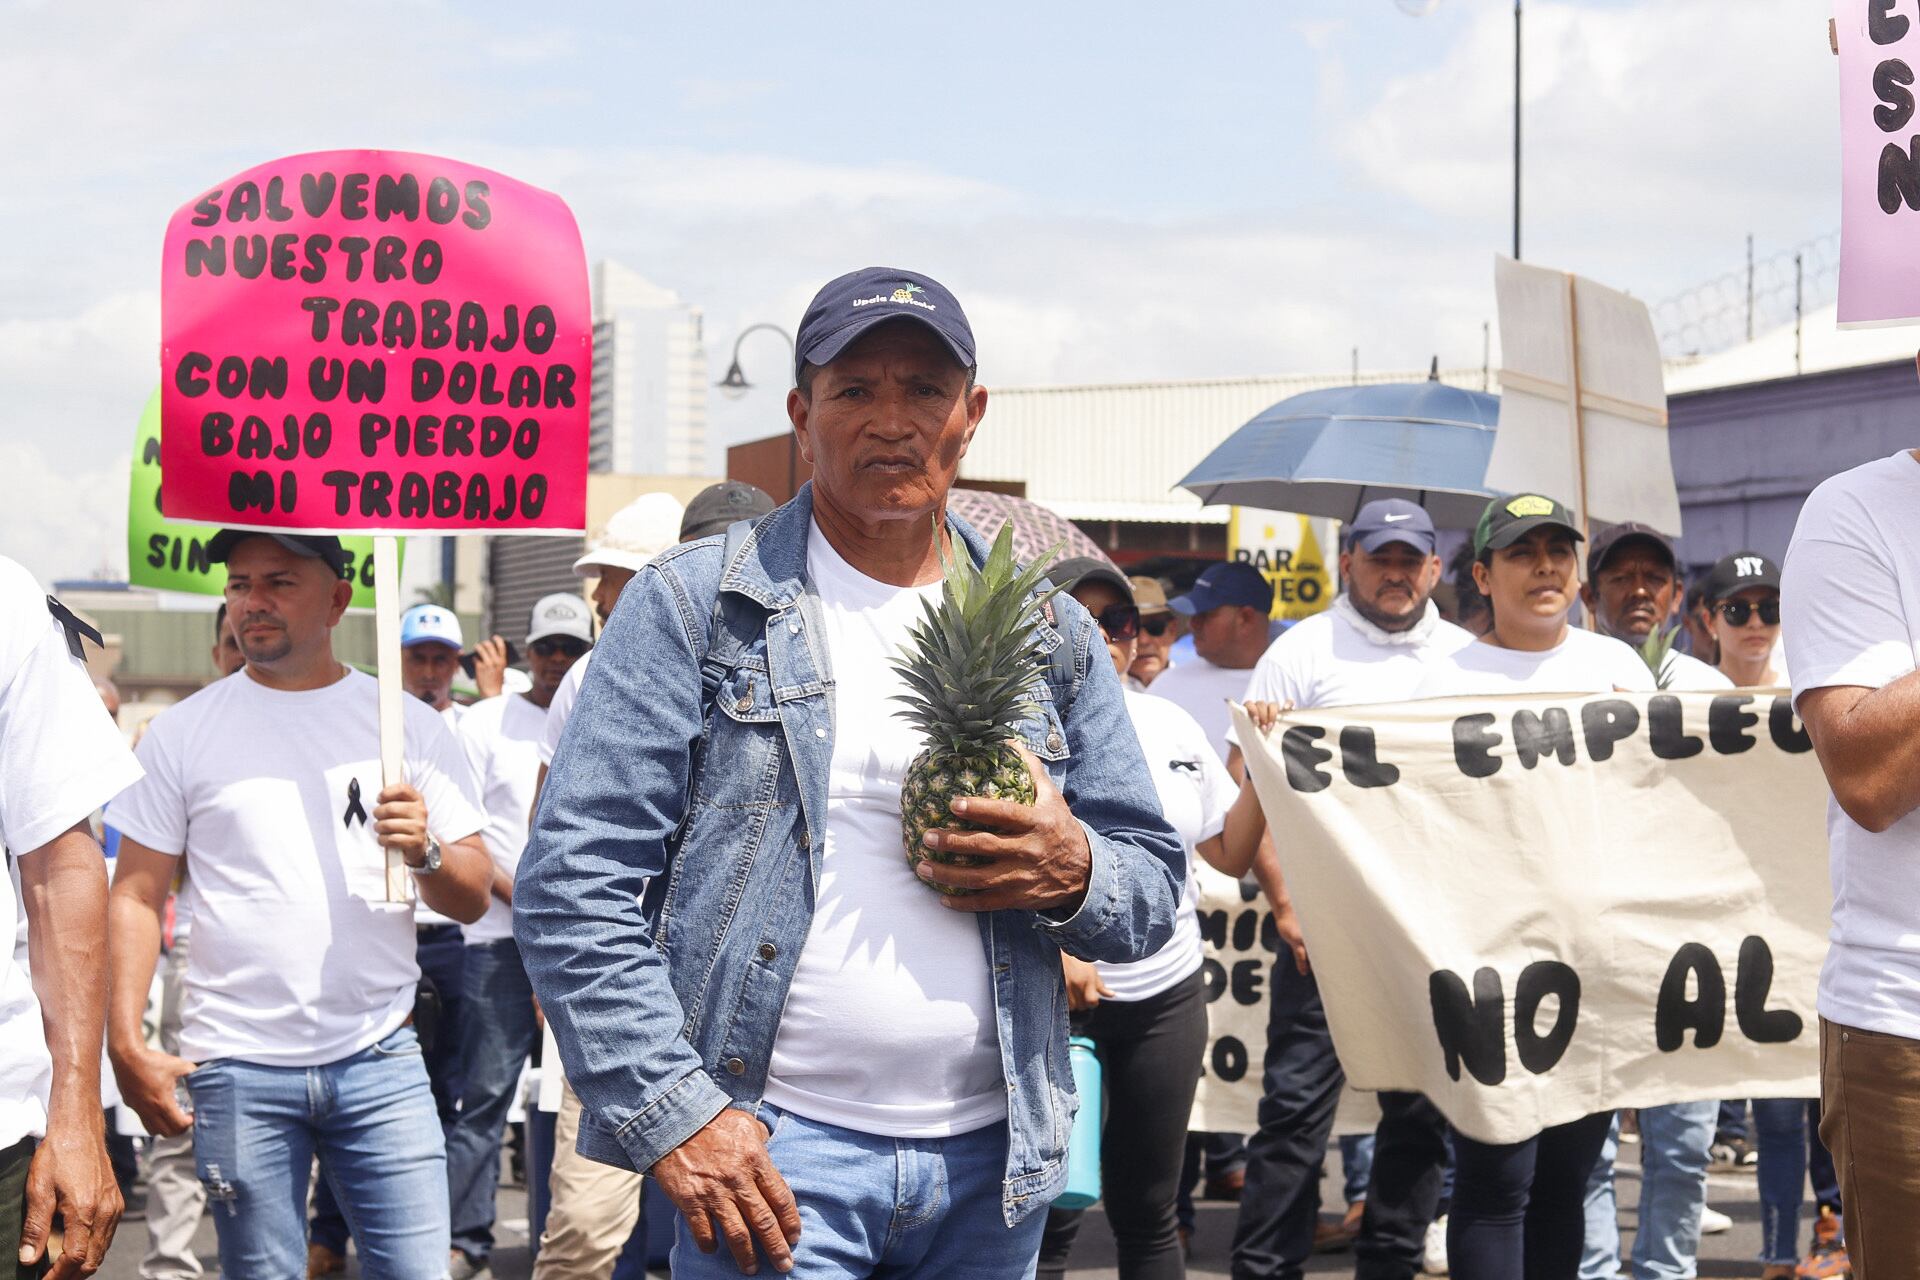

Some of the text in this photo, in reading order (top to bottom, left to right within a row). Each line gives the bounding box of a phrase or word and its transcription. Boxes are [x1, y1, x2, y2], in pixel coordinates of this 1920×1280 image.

[191, 172, 491, 230] SALVEMOS
[185, 233, 443, 284] NUESTRO
[301, 296, 556, 354] TRABAJO
[174, 351, 576, 409] CON UN DOLAR
[201, 412, 332, 461] BAJO
[359, 413, 541, 460] PIERDO
[228, 469, 548, 520] MI TRABAJO
[1734, 557, 1763, 577] NY
[1281, 725, 1400, 793] EL
[1429, 935, 1803, 1087] NO AL
